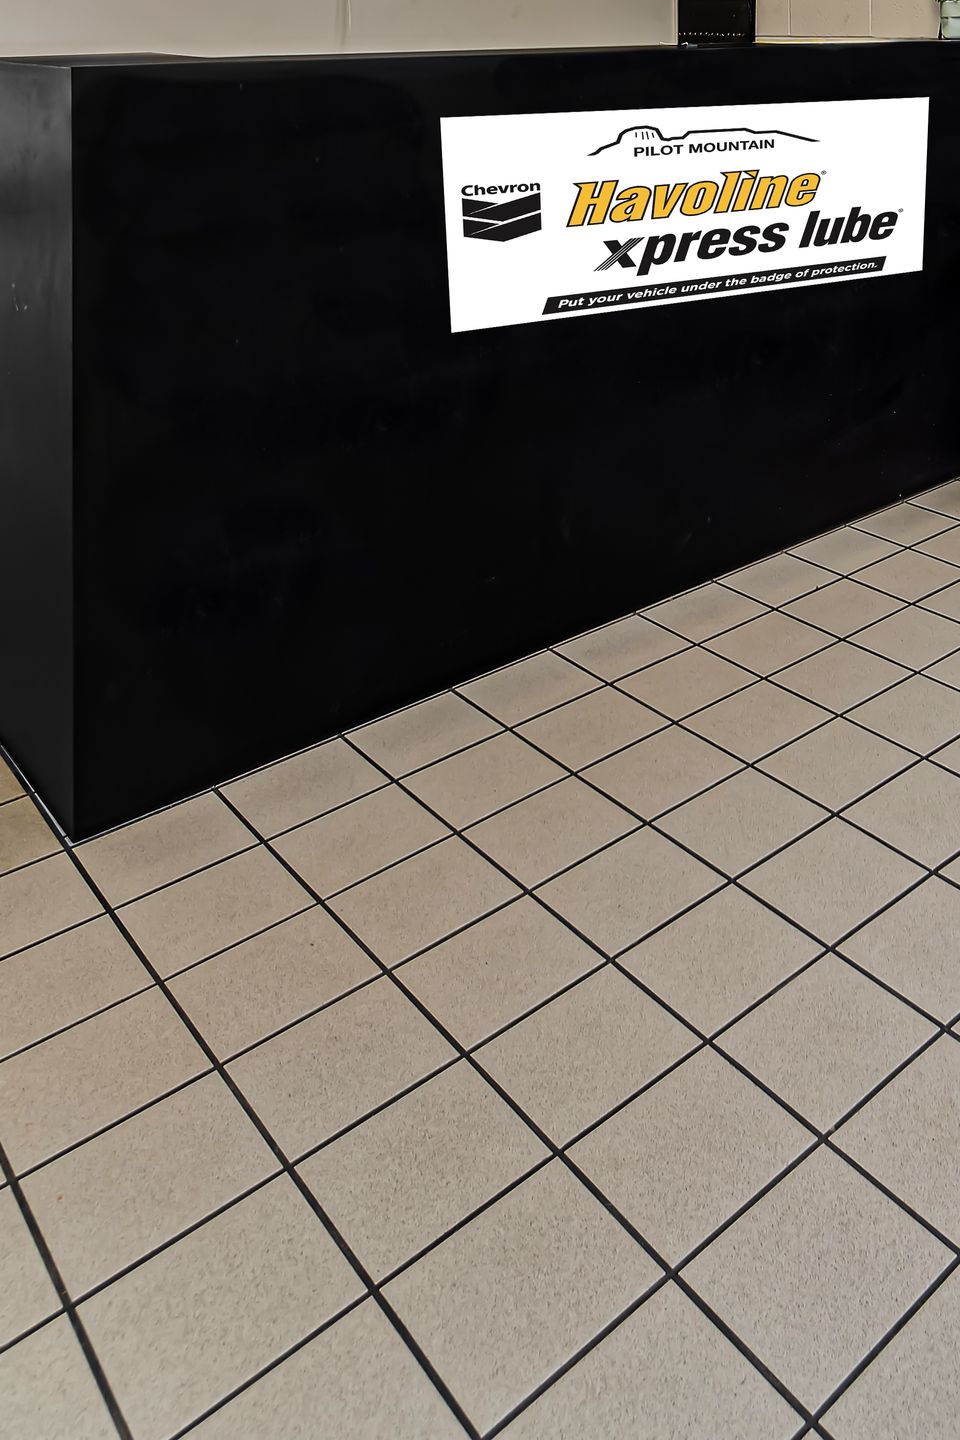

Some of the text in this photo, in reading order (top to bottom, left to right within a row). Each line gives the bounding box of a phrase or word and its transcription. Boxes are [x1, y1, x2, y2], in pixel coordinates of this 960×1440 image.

[634, 139, 775, 157] PILOT MOUNTAIN
[461, 182, 541, 197] Chevron
[566, 169, 821, 227] Havoline
[593, 206, 899, 276] xpress lube
[558, 260, 878, 309] Put your vehicle under the badge of protection.
